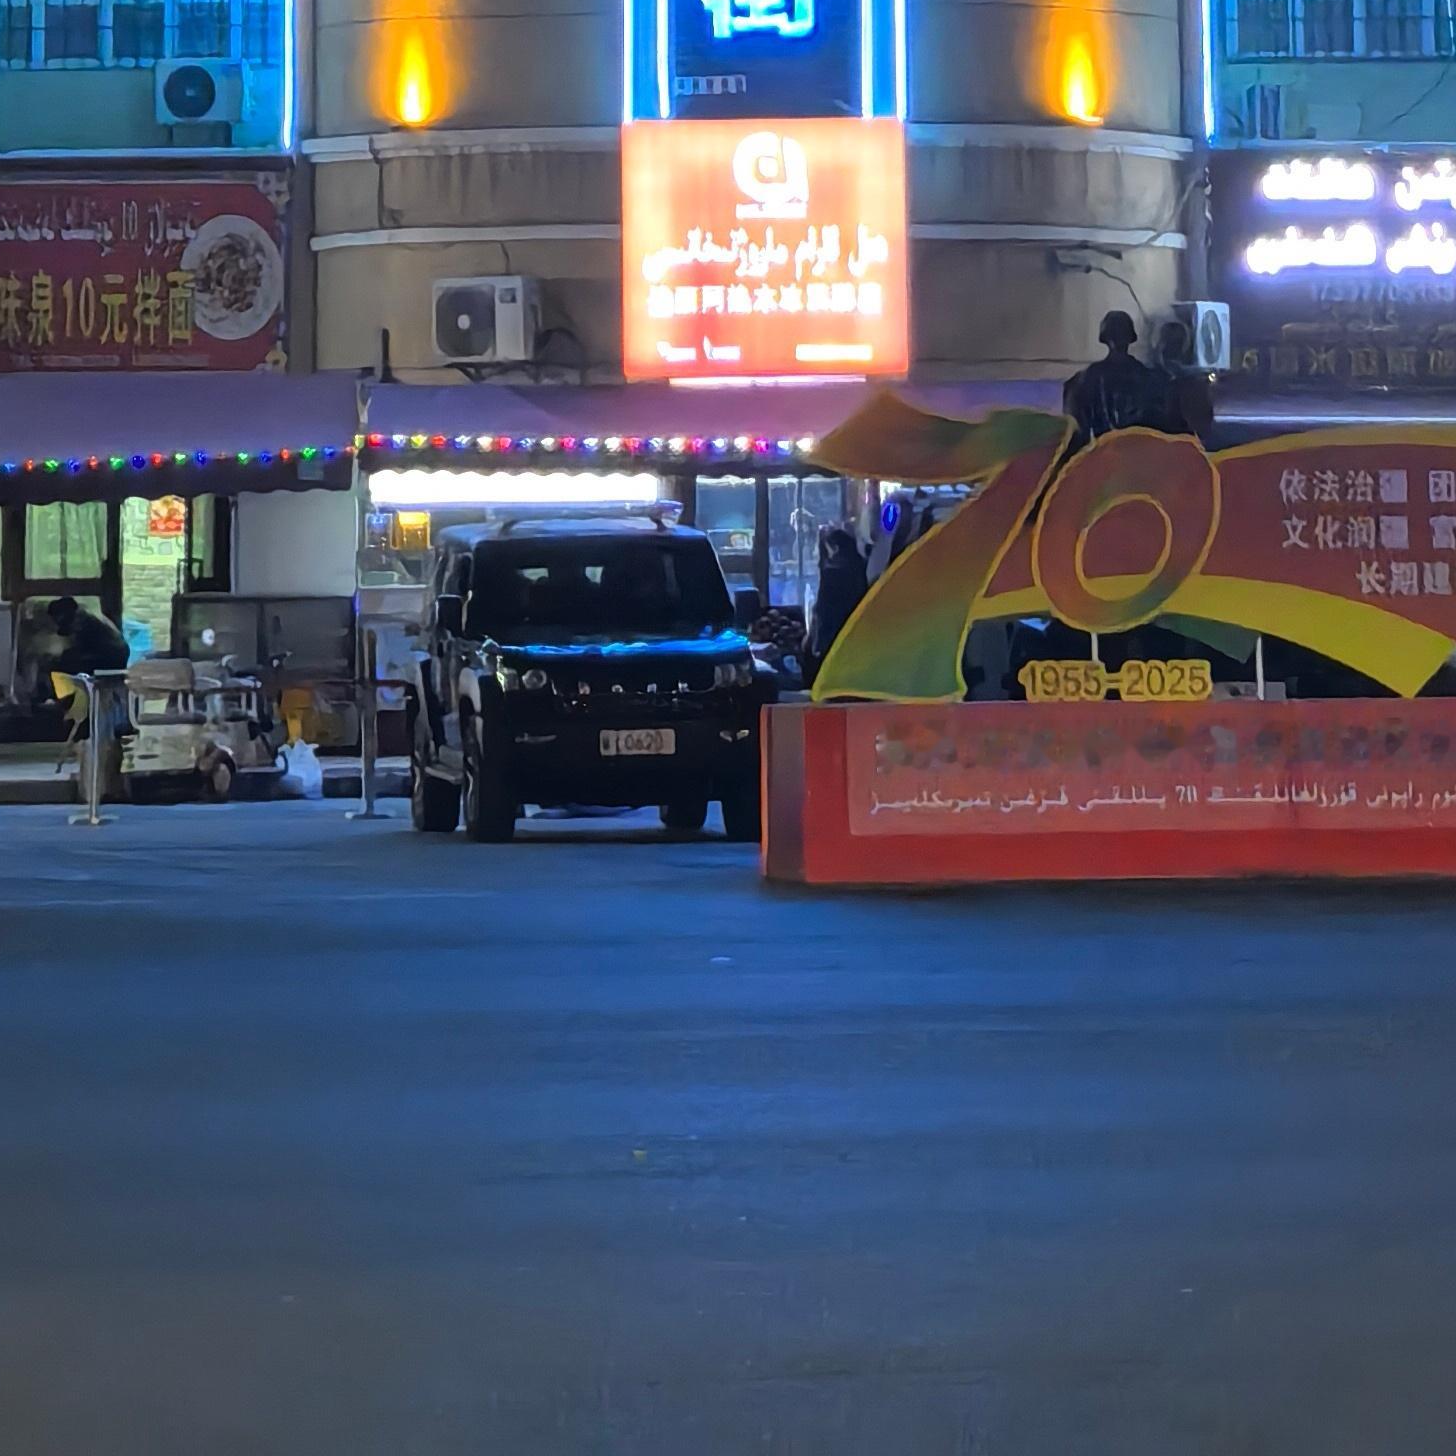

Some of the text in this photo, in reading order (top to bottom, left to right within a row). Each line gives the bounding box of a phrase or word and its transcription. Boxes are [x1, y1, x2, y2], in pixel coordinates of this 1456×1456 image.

[1280, 468, 1408, 505] 依法治
[1282, 514, 1410, 550] 文化润
[1028, 664, 1210, 697] 1955-2025
